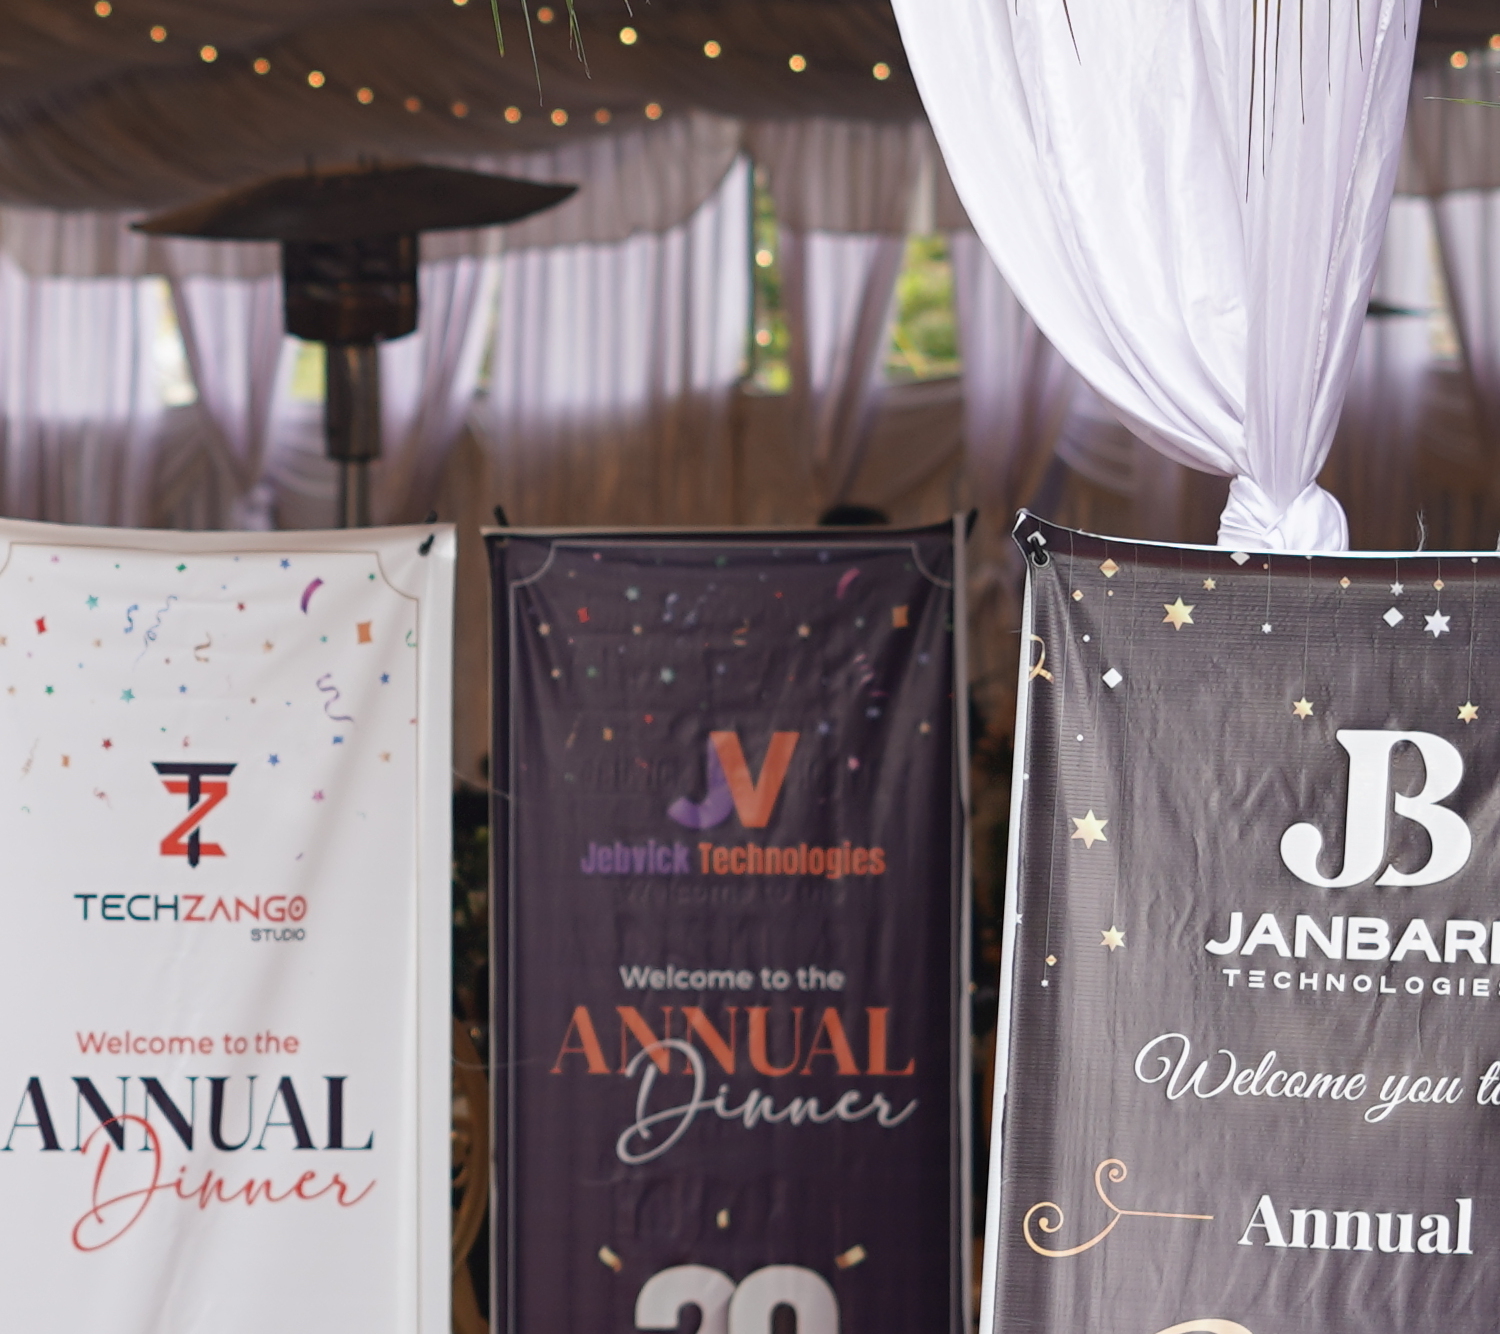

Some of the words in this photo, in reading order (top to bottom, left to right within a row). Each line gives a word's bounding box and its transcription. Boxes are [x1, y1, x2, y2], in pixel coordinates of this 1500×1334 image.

[1280, 729, 1471, 888] JB
[698, 841, 886, 879] Technologies
[251, 928, 305, 942] STUDIO
[619, 965, 753, 990] Welcome
[760, 968, 791, 991] to
[797, 965, 845, 991] the
[76, 1031, 213, 1055] Welcome
[223, 1034, 248, 1054] to
[255, 1030, 299, 1054] the
[550, 1005, 914, 1076] ANNUAL
[616, 1038, 918, 1164] Dinner
[1134, 1033, 1366, 1103] Welcome
[1363, 1072, 1462, 1123] you
[1, 1076, 374, 1152] ANNUAL
[72, 1114, 376, 1252] Dinner
[1238, 1195, 1473, 1254] Annual
